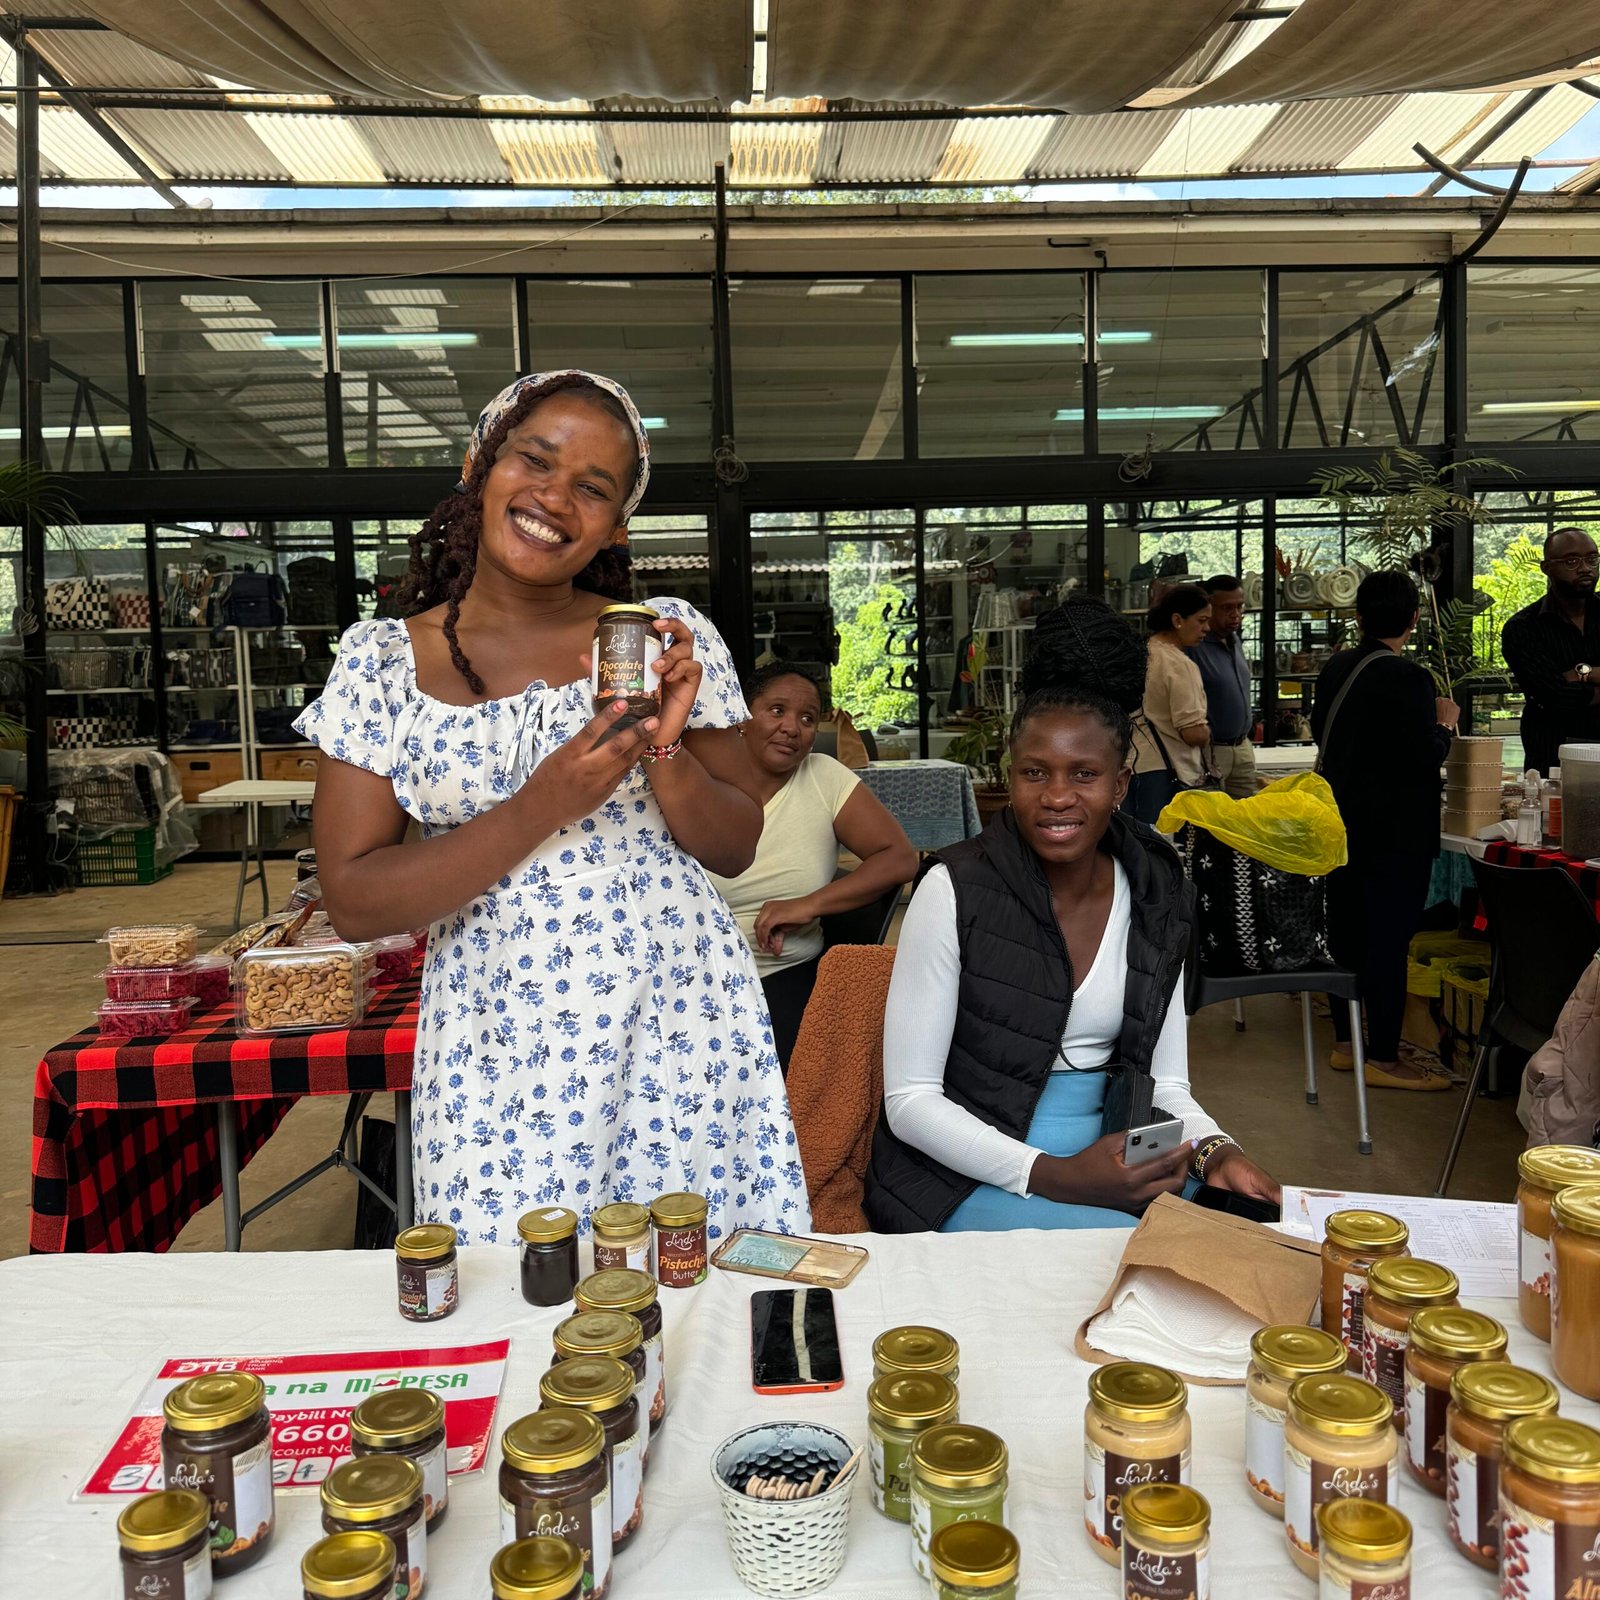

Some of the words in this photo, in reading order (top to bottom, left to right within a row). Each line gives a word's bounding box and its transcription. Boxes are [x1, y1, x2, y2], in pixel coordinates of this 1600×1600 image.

[605, 633, 637, 654] Linda's
[599, 659, 644, 672] Chocolate
[603, 671, 637, 682] Peanut
[665, 1230, 702, 1251] Linda's
[595, 1247, 620, 1265] Linda's
[672, 1269, 699, 1280] Butter
[177, 1361, 238, 1373] DTB
[170, 1464, 215, 1490] Linda's
[1115, 1463, 1169, 1485] Linda's
[1322, 1466, 1378, 1497] Linda's
[528, 1511, 580, 1537] Linda's
[1130, 1549, 1182, 1585] Linda's
